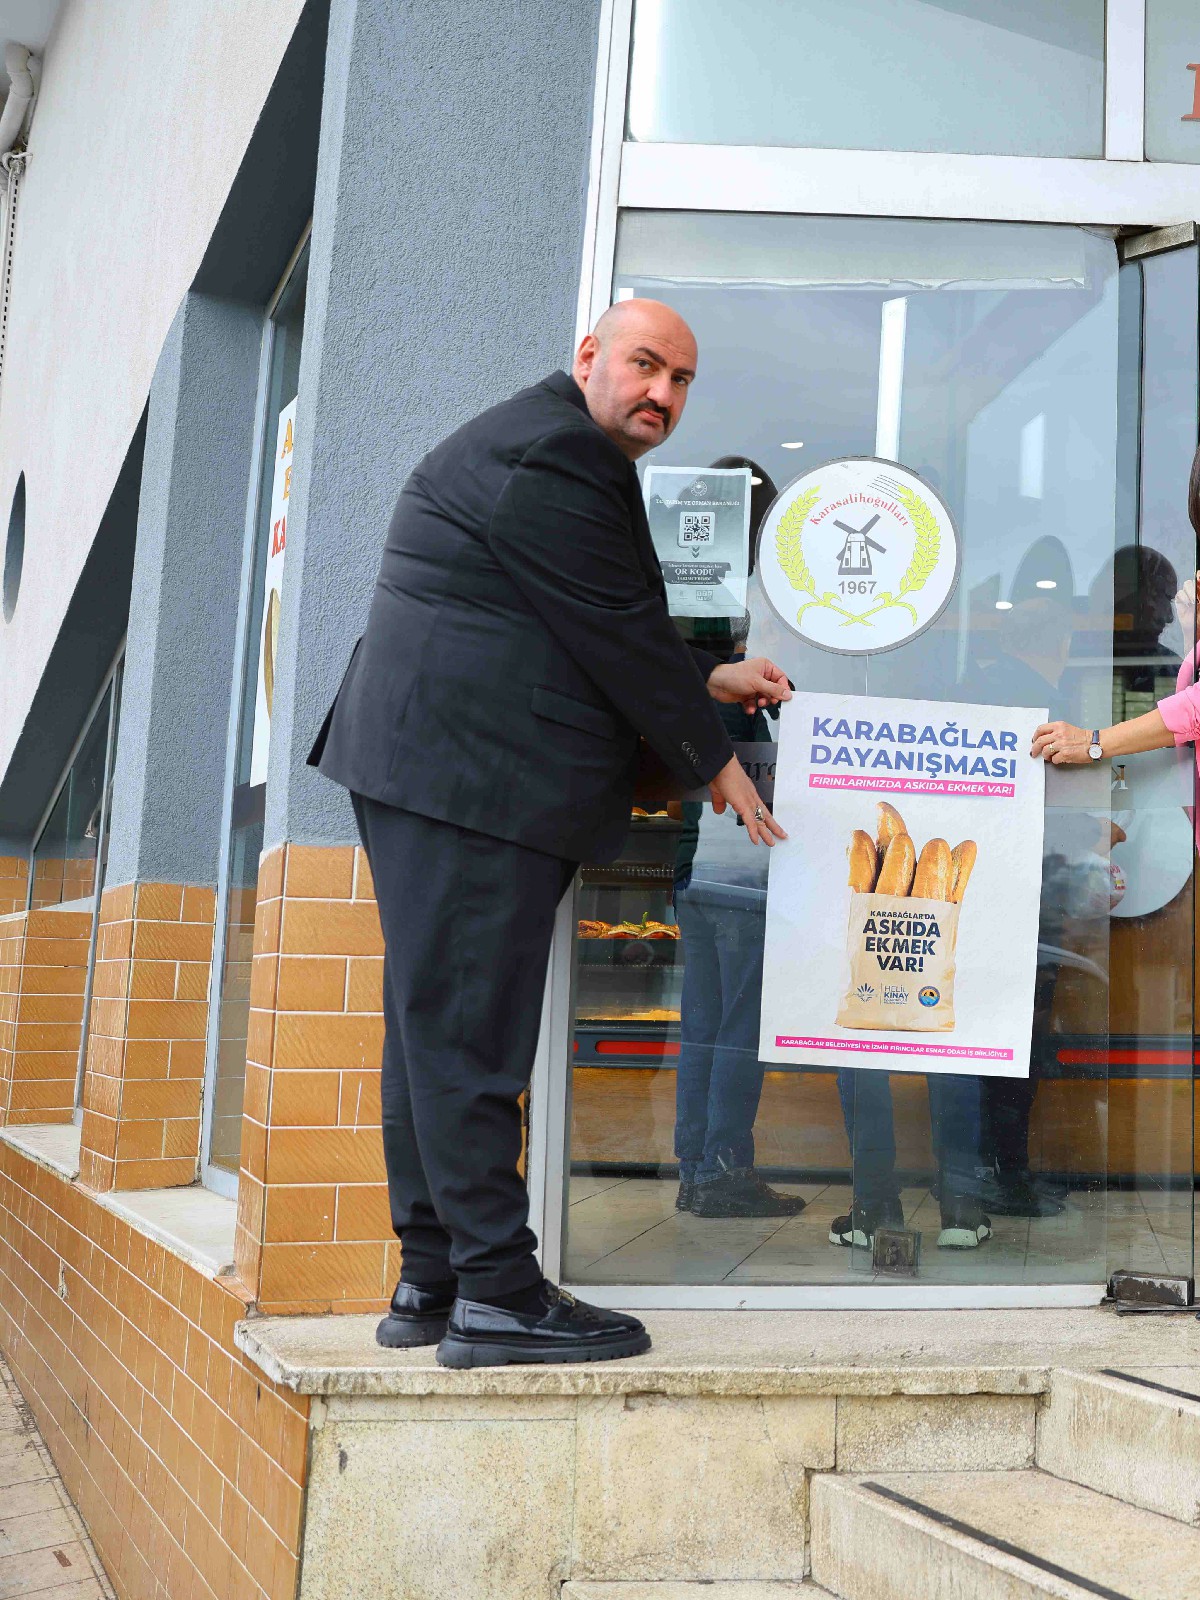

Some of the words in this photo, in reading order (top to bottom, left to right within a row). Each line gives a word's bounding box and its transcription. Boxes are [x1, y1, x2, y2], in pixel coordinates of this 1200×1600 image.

[809, 492, 909, 527] Karasalihoğulları
[674, 568, 688, 576] QR
[689, 568, 715, 576] KODU
[838, 580, 878, 595] 1967
[812, 716, 1018, 752] KARABAĞLAR
[810, 743, 1017, 779] DAYANIŞMASI
[812, 776, 902, 790] FIRINLARIMIZDA
[903, 781, 945, 791] ASKIDA
[947, 783, 985, 793] EKMEK
[987, 785, 1013, 795] VAR!
[862, 918, 941, 938] ASKIDA
[865, 936, 936, 956] EKMEK
[876, 954, 924, 973] VAR!
[781, 1038, 825, 1047] KARABAĞLAR
